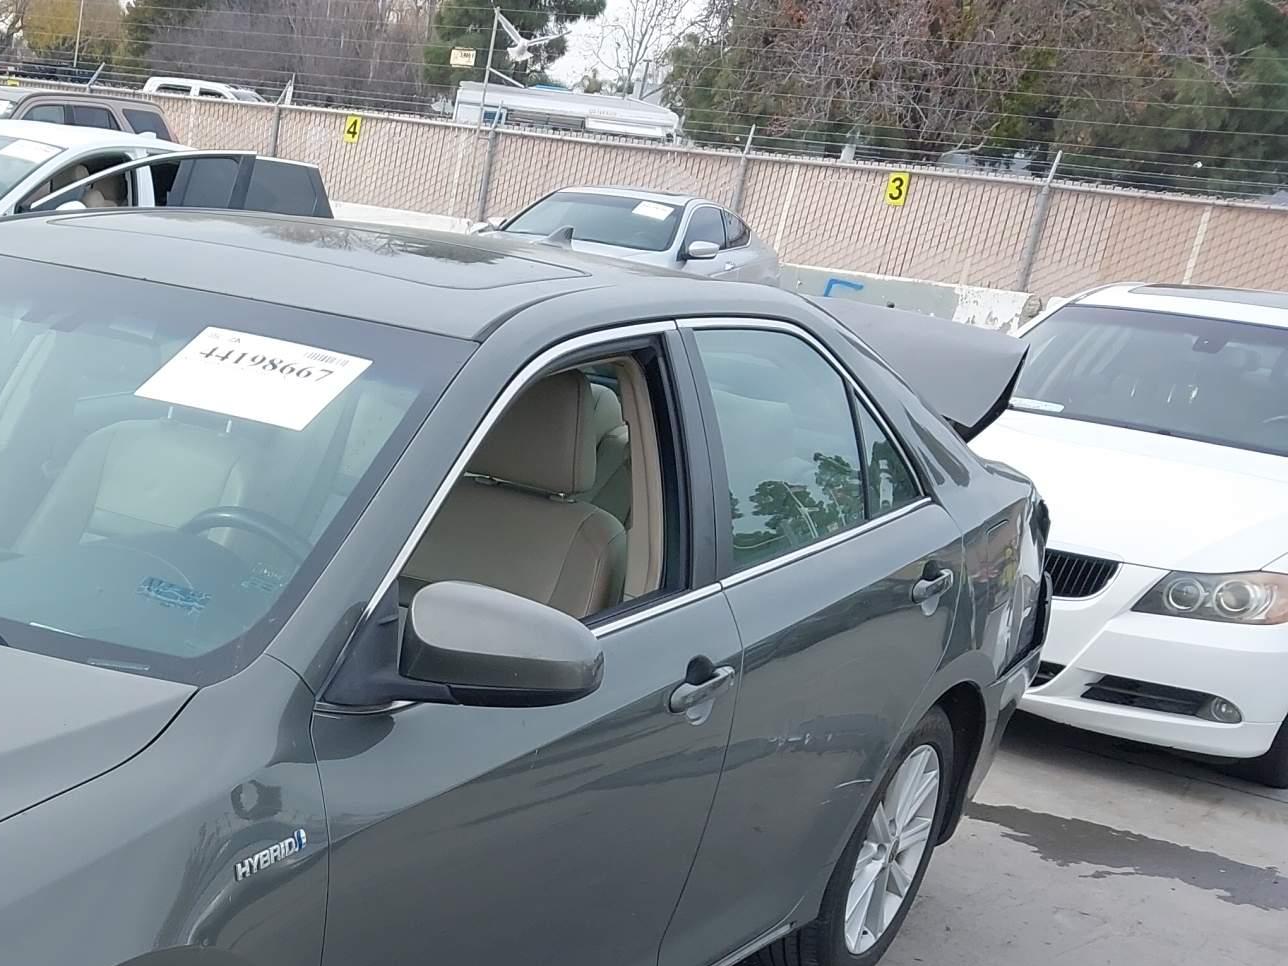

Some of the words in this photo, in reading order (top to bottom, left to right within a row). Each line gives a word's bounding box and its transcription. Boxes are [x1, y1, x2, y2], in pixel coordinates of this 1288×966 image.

[347, 119, 357, 138] 4
[889, 177, 904, 200] 3
[199, 346, 336, 382] 44198667
[233, 837, 297, 881] HYBRID
